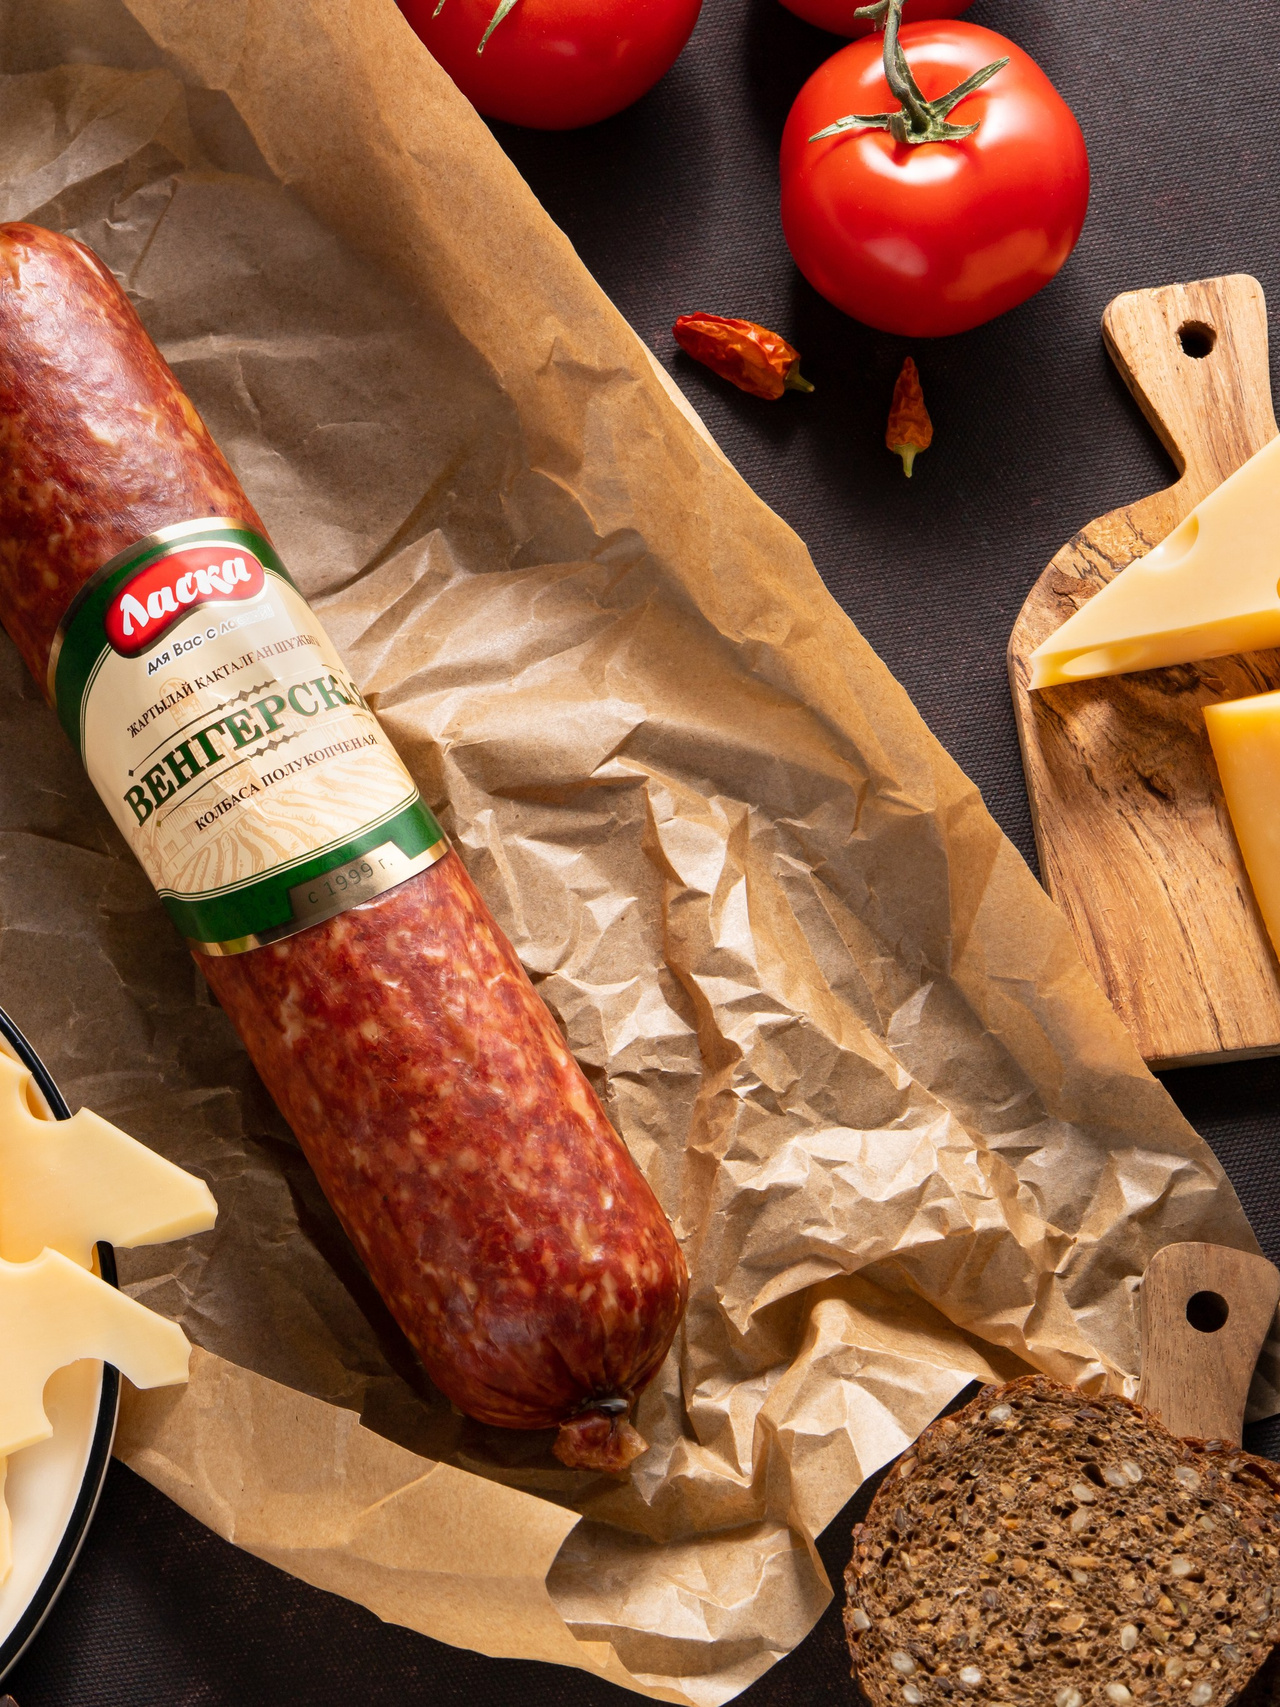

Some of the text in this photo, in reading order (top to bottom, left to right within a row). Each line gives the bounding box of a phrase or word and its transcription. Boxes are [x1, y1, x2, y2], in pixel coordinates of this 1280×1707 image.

[119, 557, 252, 636] Ласка
[147, 651, 171, 675] для
[172, 635, 202, 657] Вас
[206, 628, 217, 639] с
[126, 681, 195, 738] ЖАРТЫЛАЙ
[194, 734, 379, 832] КОЛБАСА ПОЛУКОПЧЕНАЯ
[323, 861, 374, 897] 1999
